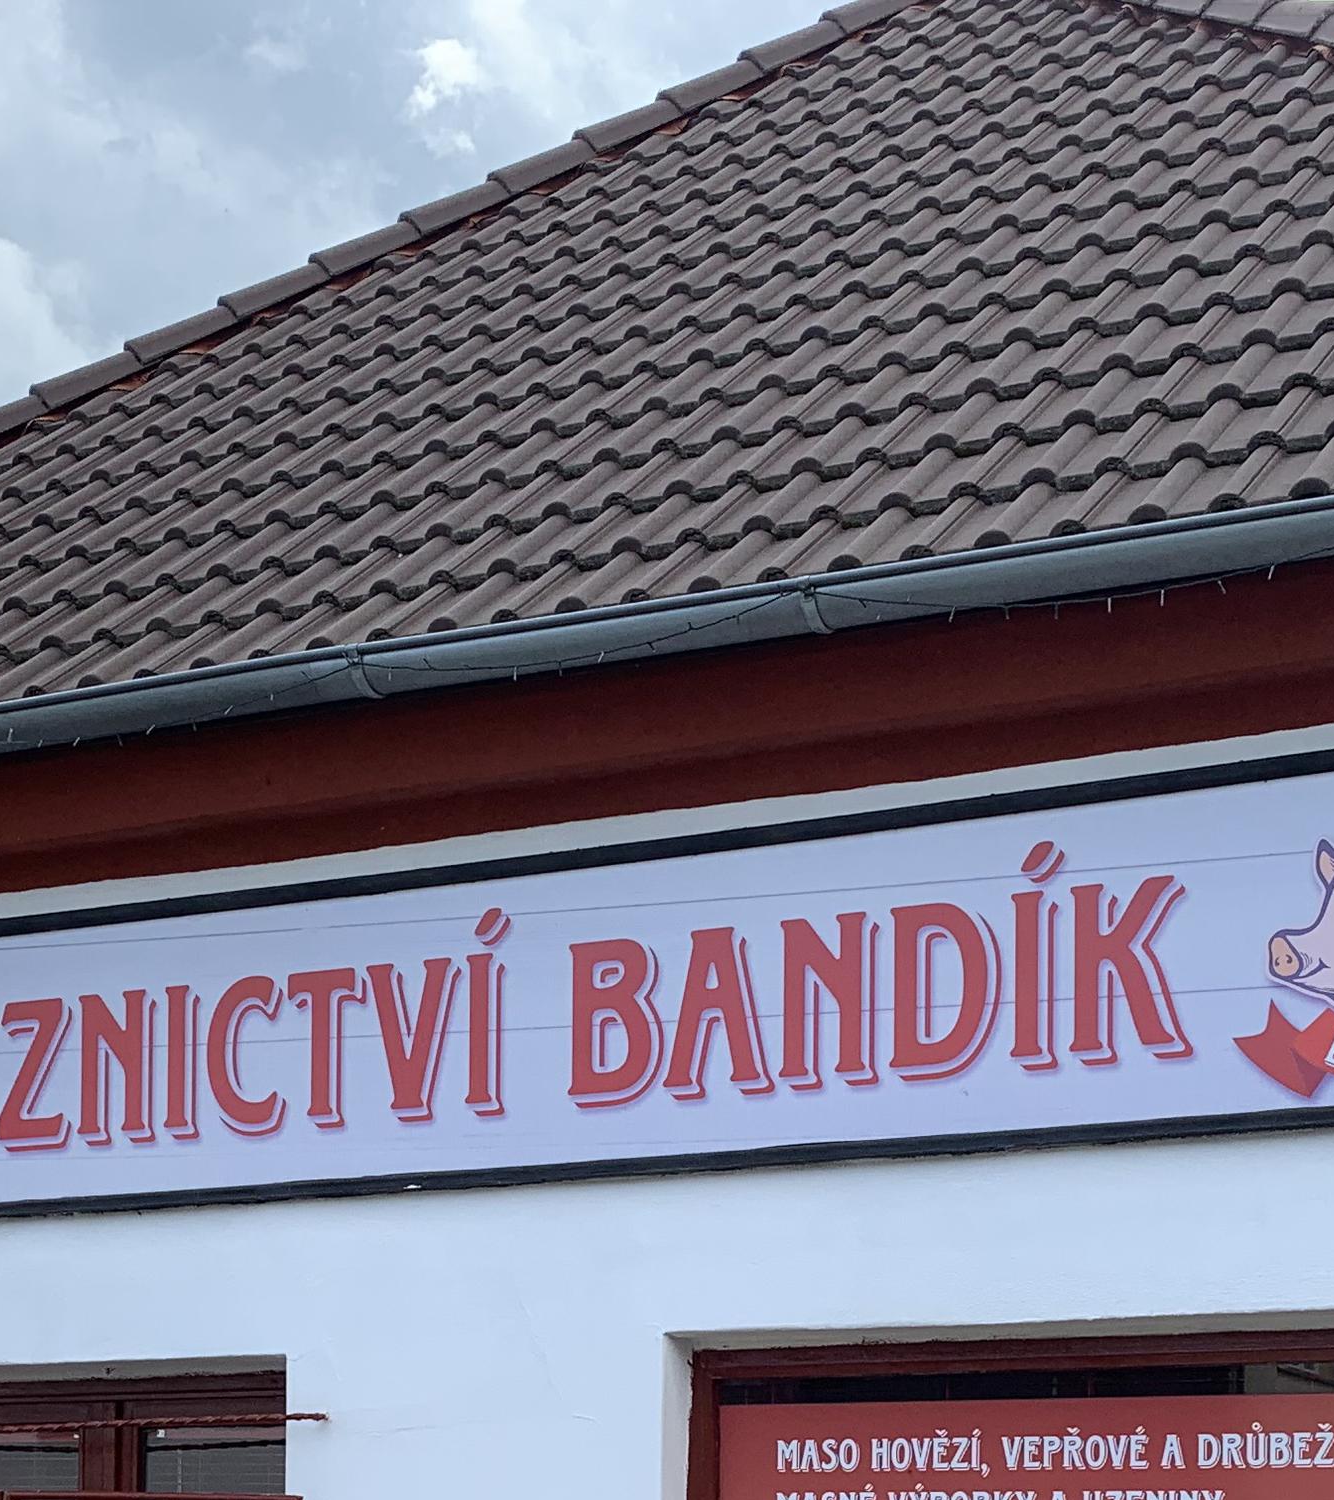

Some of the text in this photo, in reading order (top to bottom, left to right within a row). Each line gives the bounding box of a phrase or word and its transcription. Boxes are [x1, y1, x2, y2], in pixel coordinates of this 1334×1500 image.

[568, 841, 1193, 1109] BANDÍK
[776, 1437, 861, 1472] MASO
[870, 1428, 991, 1478] HOVĚZÍ,
[1001, 1425, 1150, 1471] VEPŘOVÉ
[1161, 1434, 1185, 1470] A
